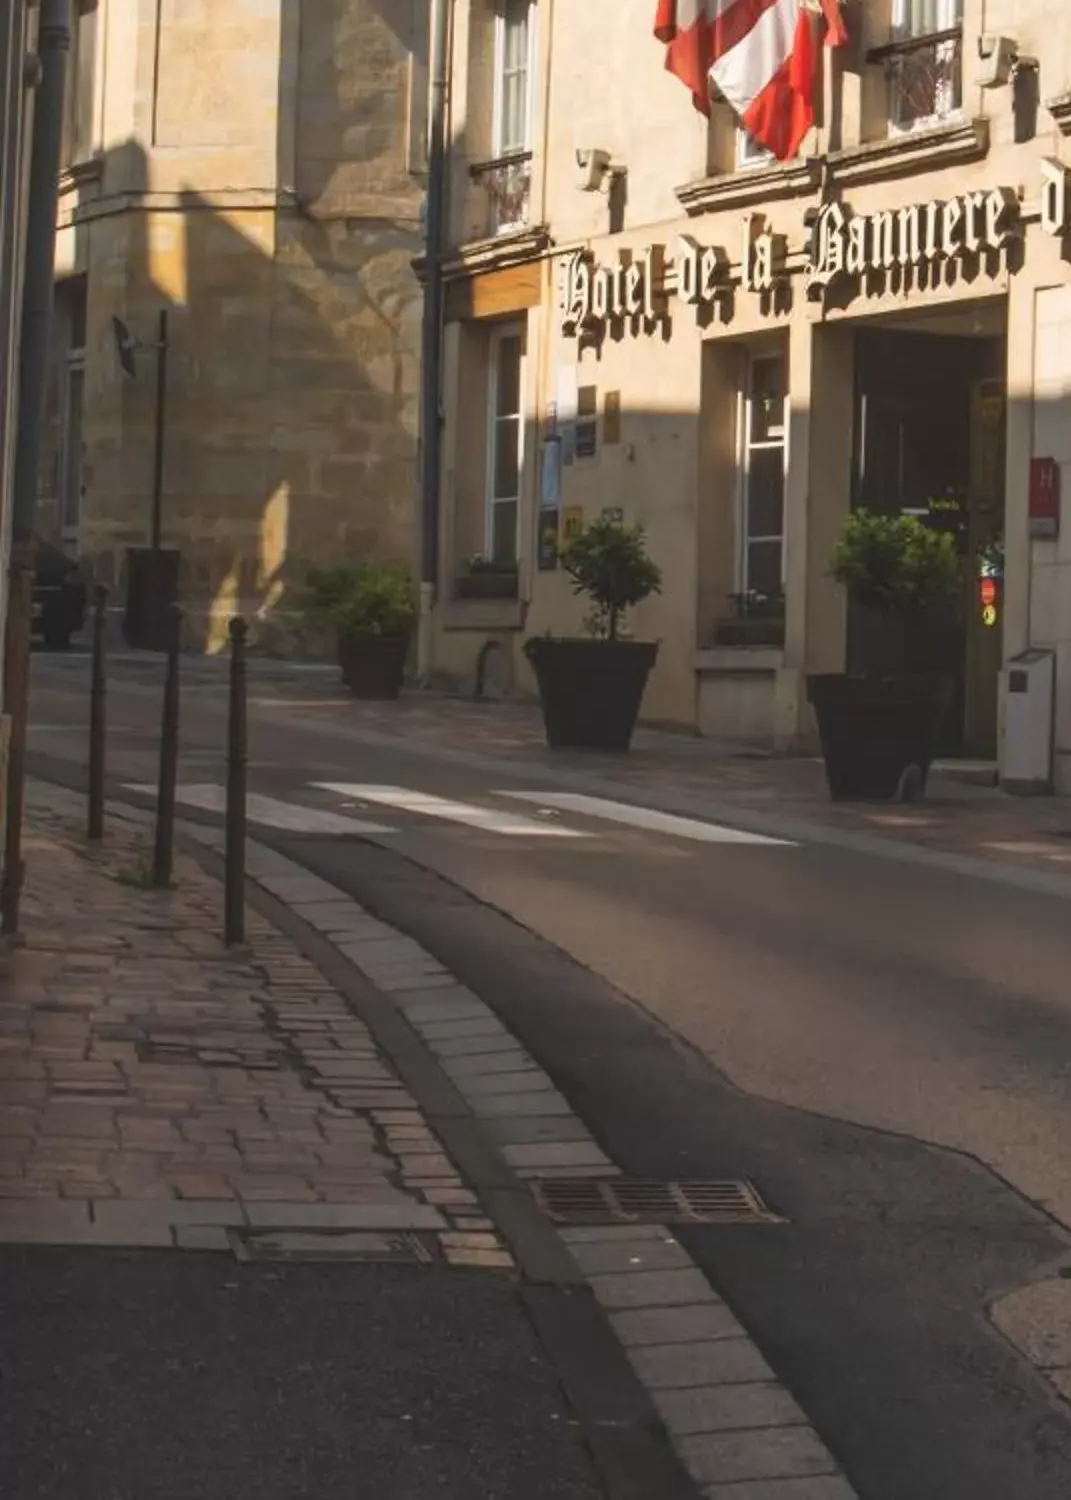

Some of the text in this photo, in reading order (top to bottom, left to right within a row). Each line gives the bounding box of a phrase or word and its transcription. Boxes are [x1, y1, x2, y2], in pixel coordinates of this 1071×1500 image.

[676, 234, 727, 301] de
[741, 213, 785, 290] la
[803, 187, 1012, 296] Banniere
